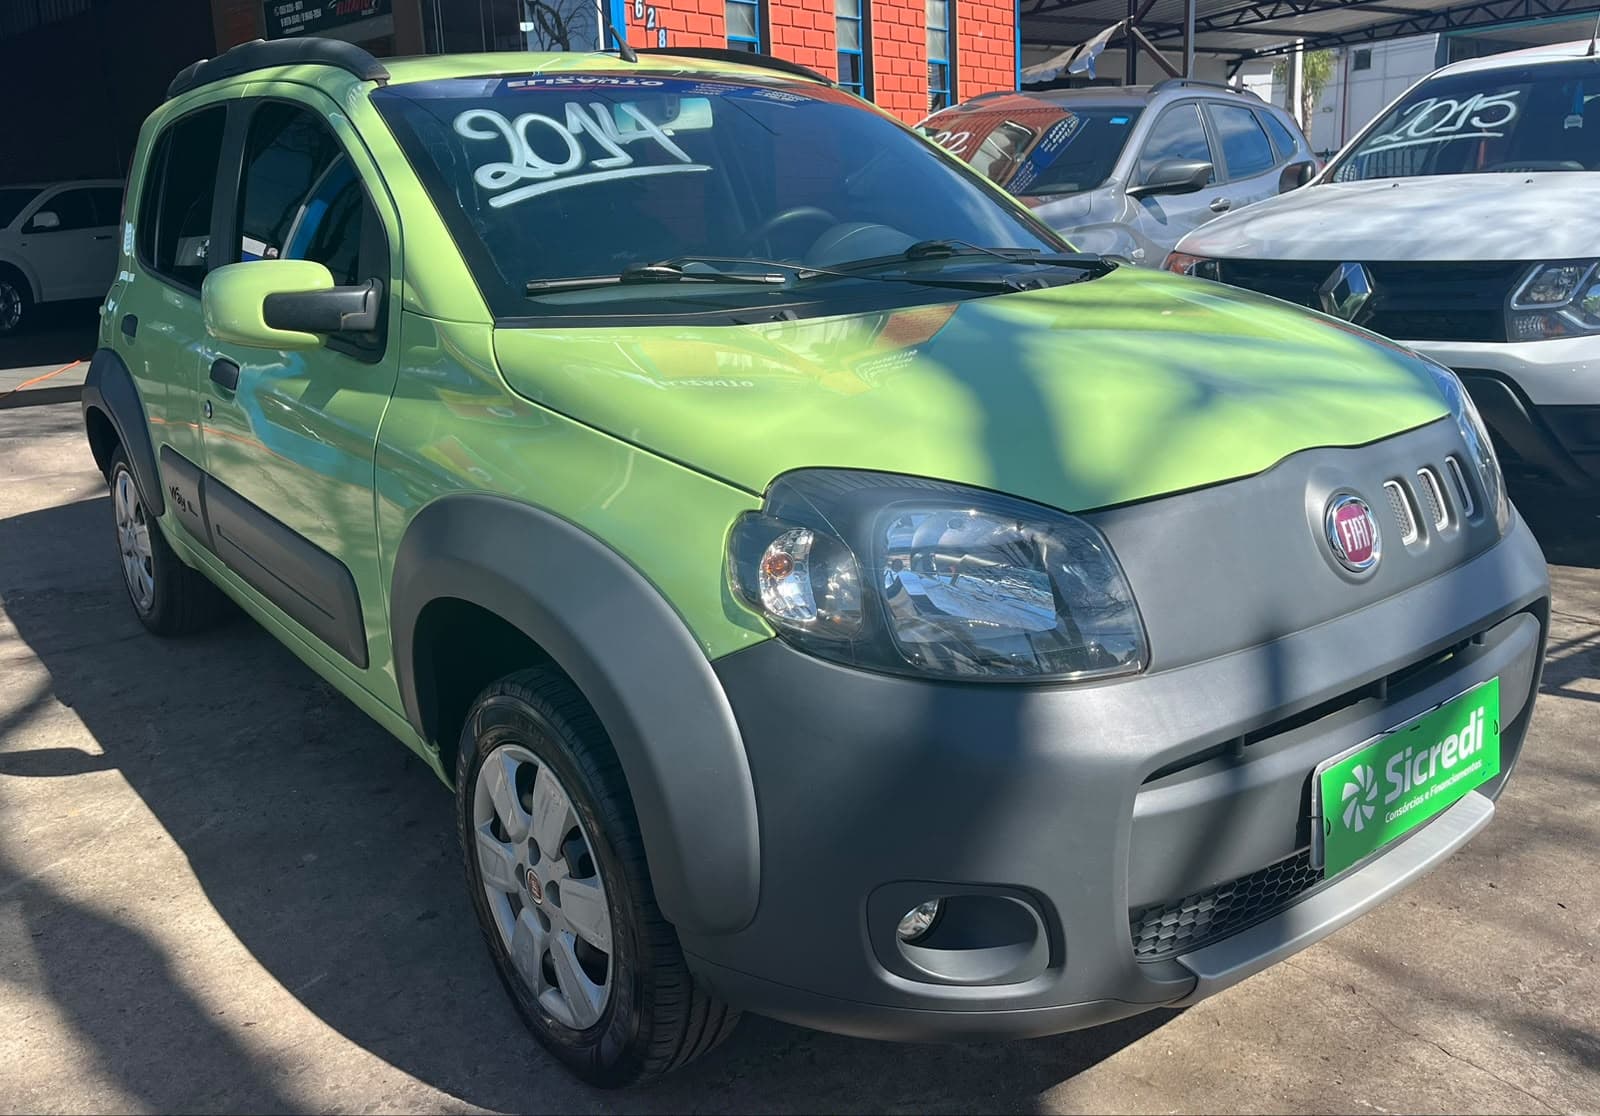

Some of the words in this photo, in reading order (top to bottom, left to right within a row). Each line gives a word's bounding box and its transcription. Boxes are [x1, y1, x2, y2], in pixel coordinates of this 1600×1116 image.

[635, 0, 666, 48] 628
[453, 101, 693, 190] 2014
[1370, 90, 1520, 145] 2015
[1340, 514, 1371, 552] FIAT
[1384, 706, 1484, 805] Sicredi
[1384, 794, 1424, 823] Consórcios
[1430, 759, 1482, 798] Financiamentos
